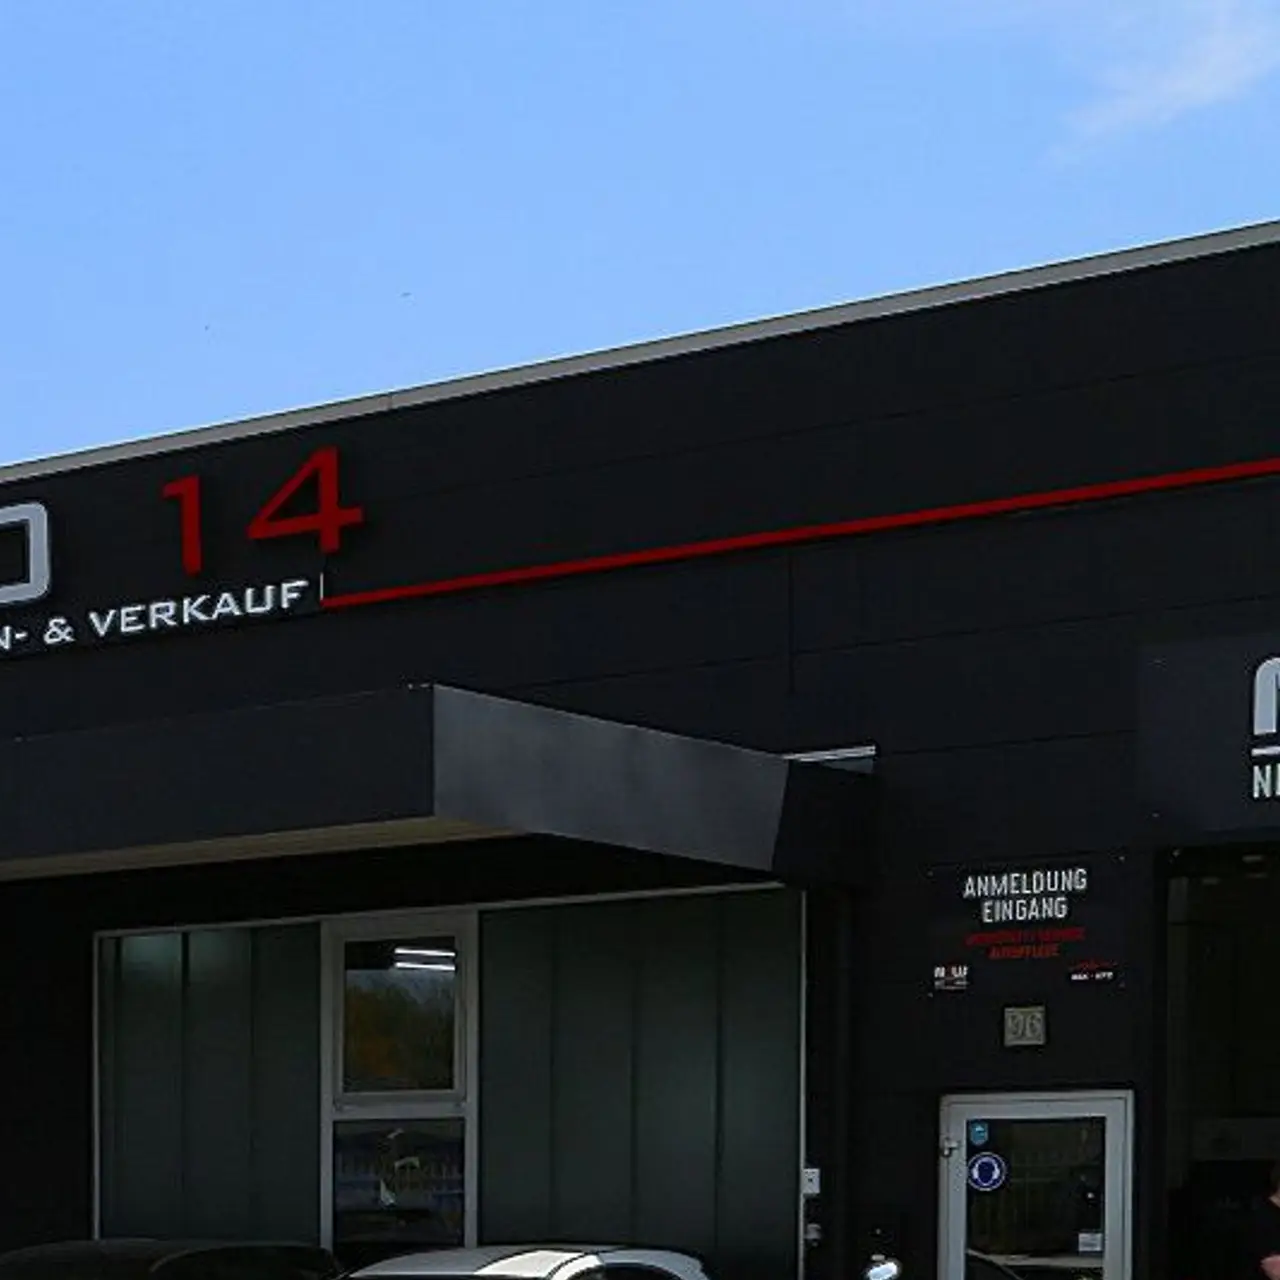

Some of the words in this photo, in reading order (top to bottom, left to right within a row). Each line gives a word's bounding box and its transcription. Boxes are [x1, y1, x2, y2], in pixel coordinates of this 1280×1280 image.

[162, 445, 364, 576] 14
[43, 617, 75, 646] &
[88, 579, 309, 637] VERKAUF
[962, 867, 1088, 899] ANMELDUNG
[982, 897, 1069, 923] EINGANG
